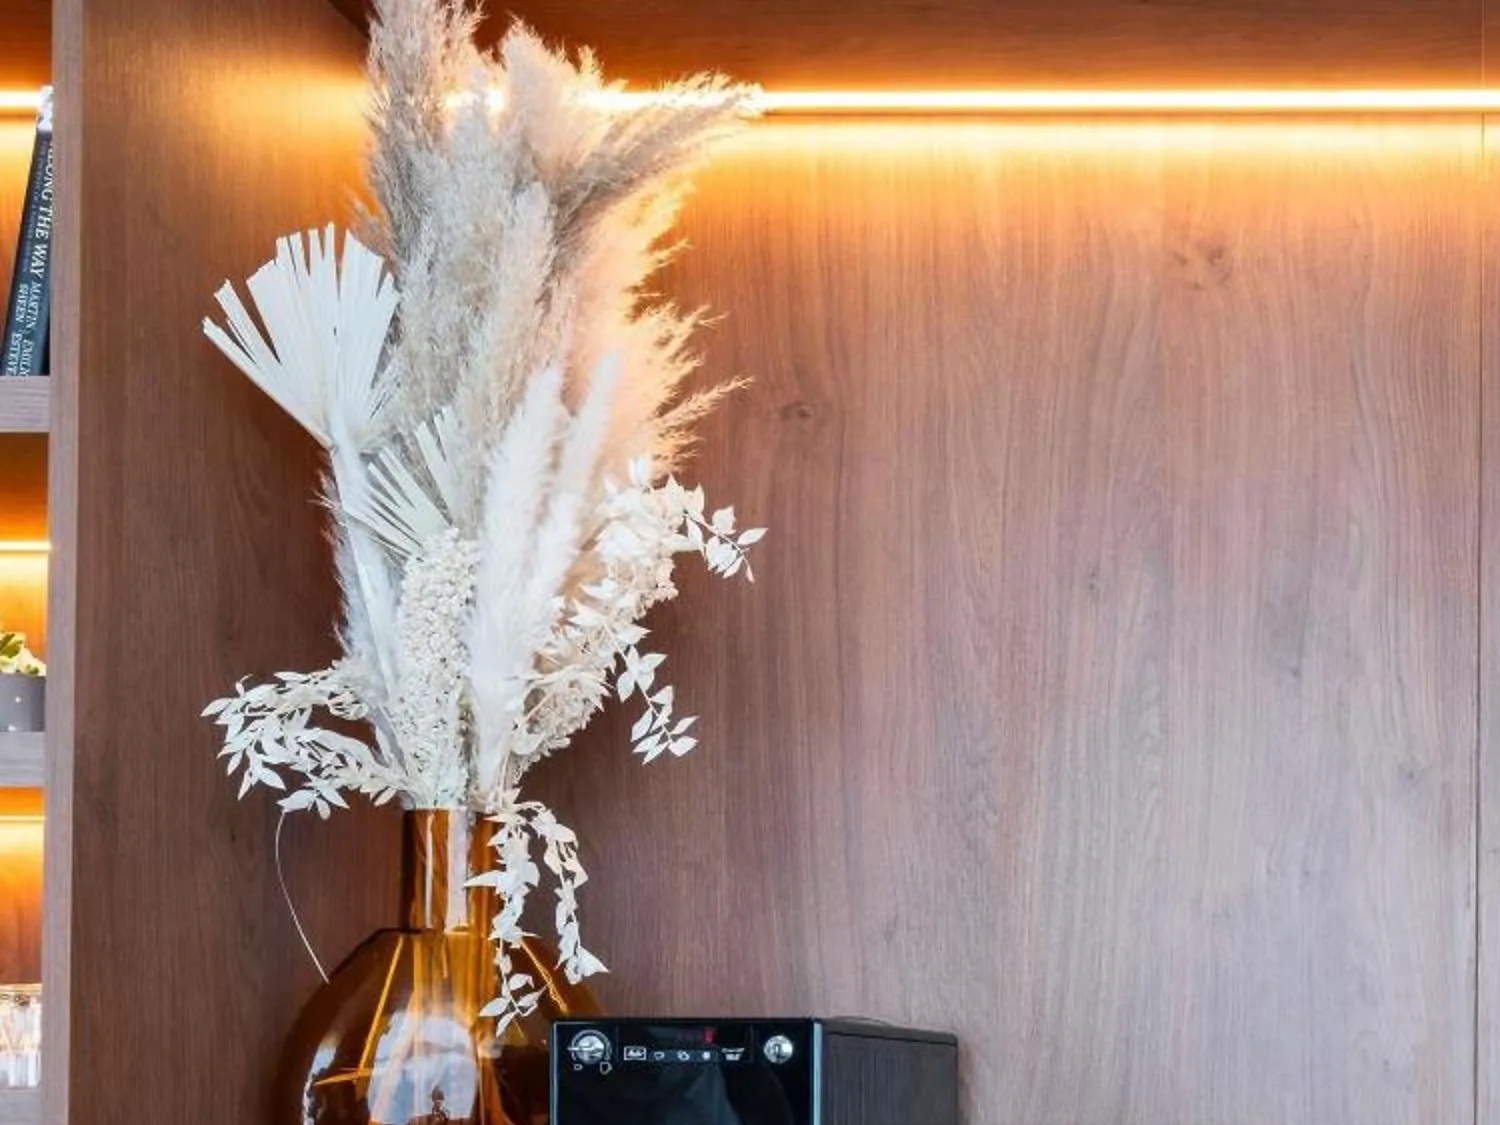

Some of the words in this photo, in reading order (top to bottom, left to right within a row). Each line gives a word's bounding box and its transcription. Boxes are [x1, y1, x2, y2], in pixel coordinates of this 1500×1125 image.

[35, 205, 53, 239] THE
[30, 243, 48, 278] WAY
[15, 283, 29, 322] SHEEN
[26, 280, 42, 329] MARTIN
